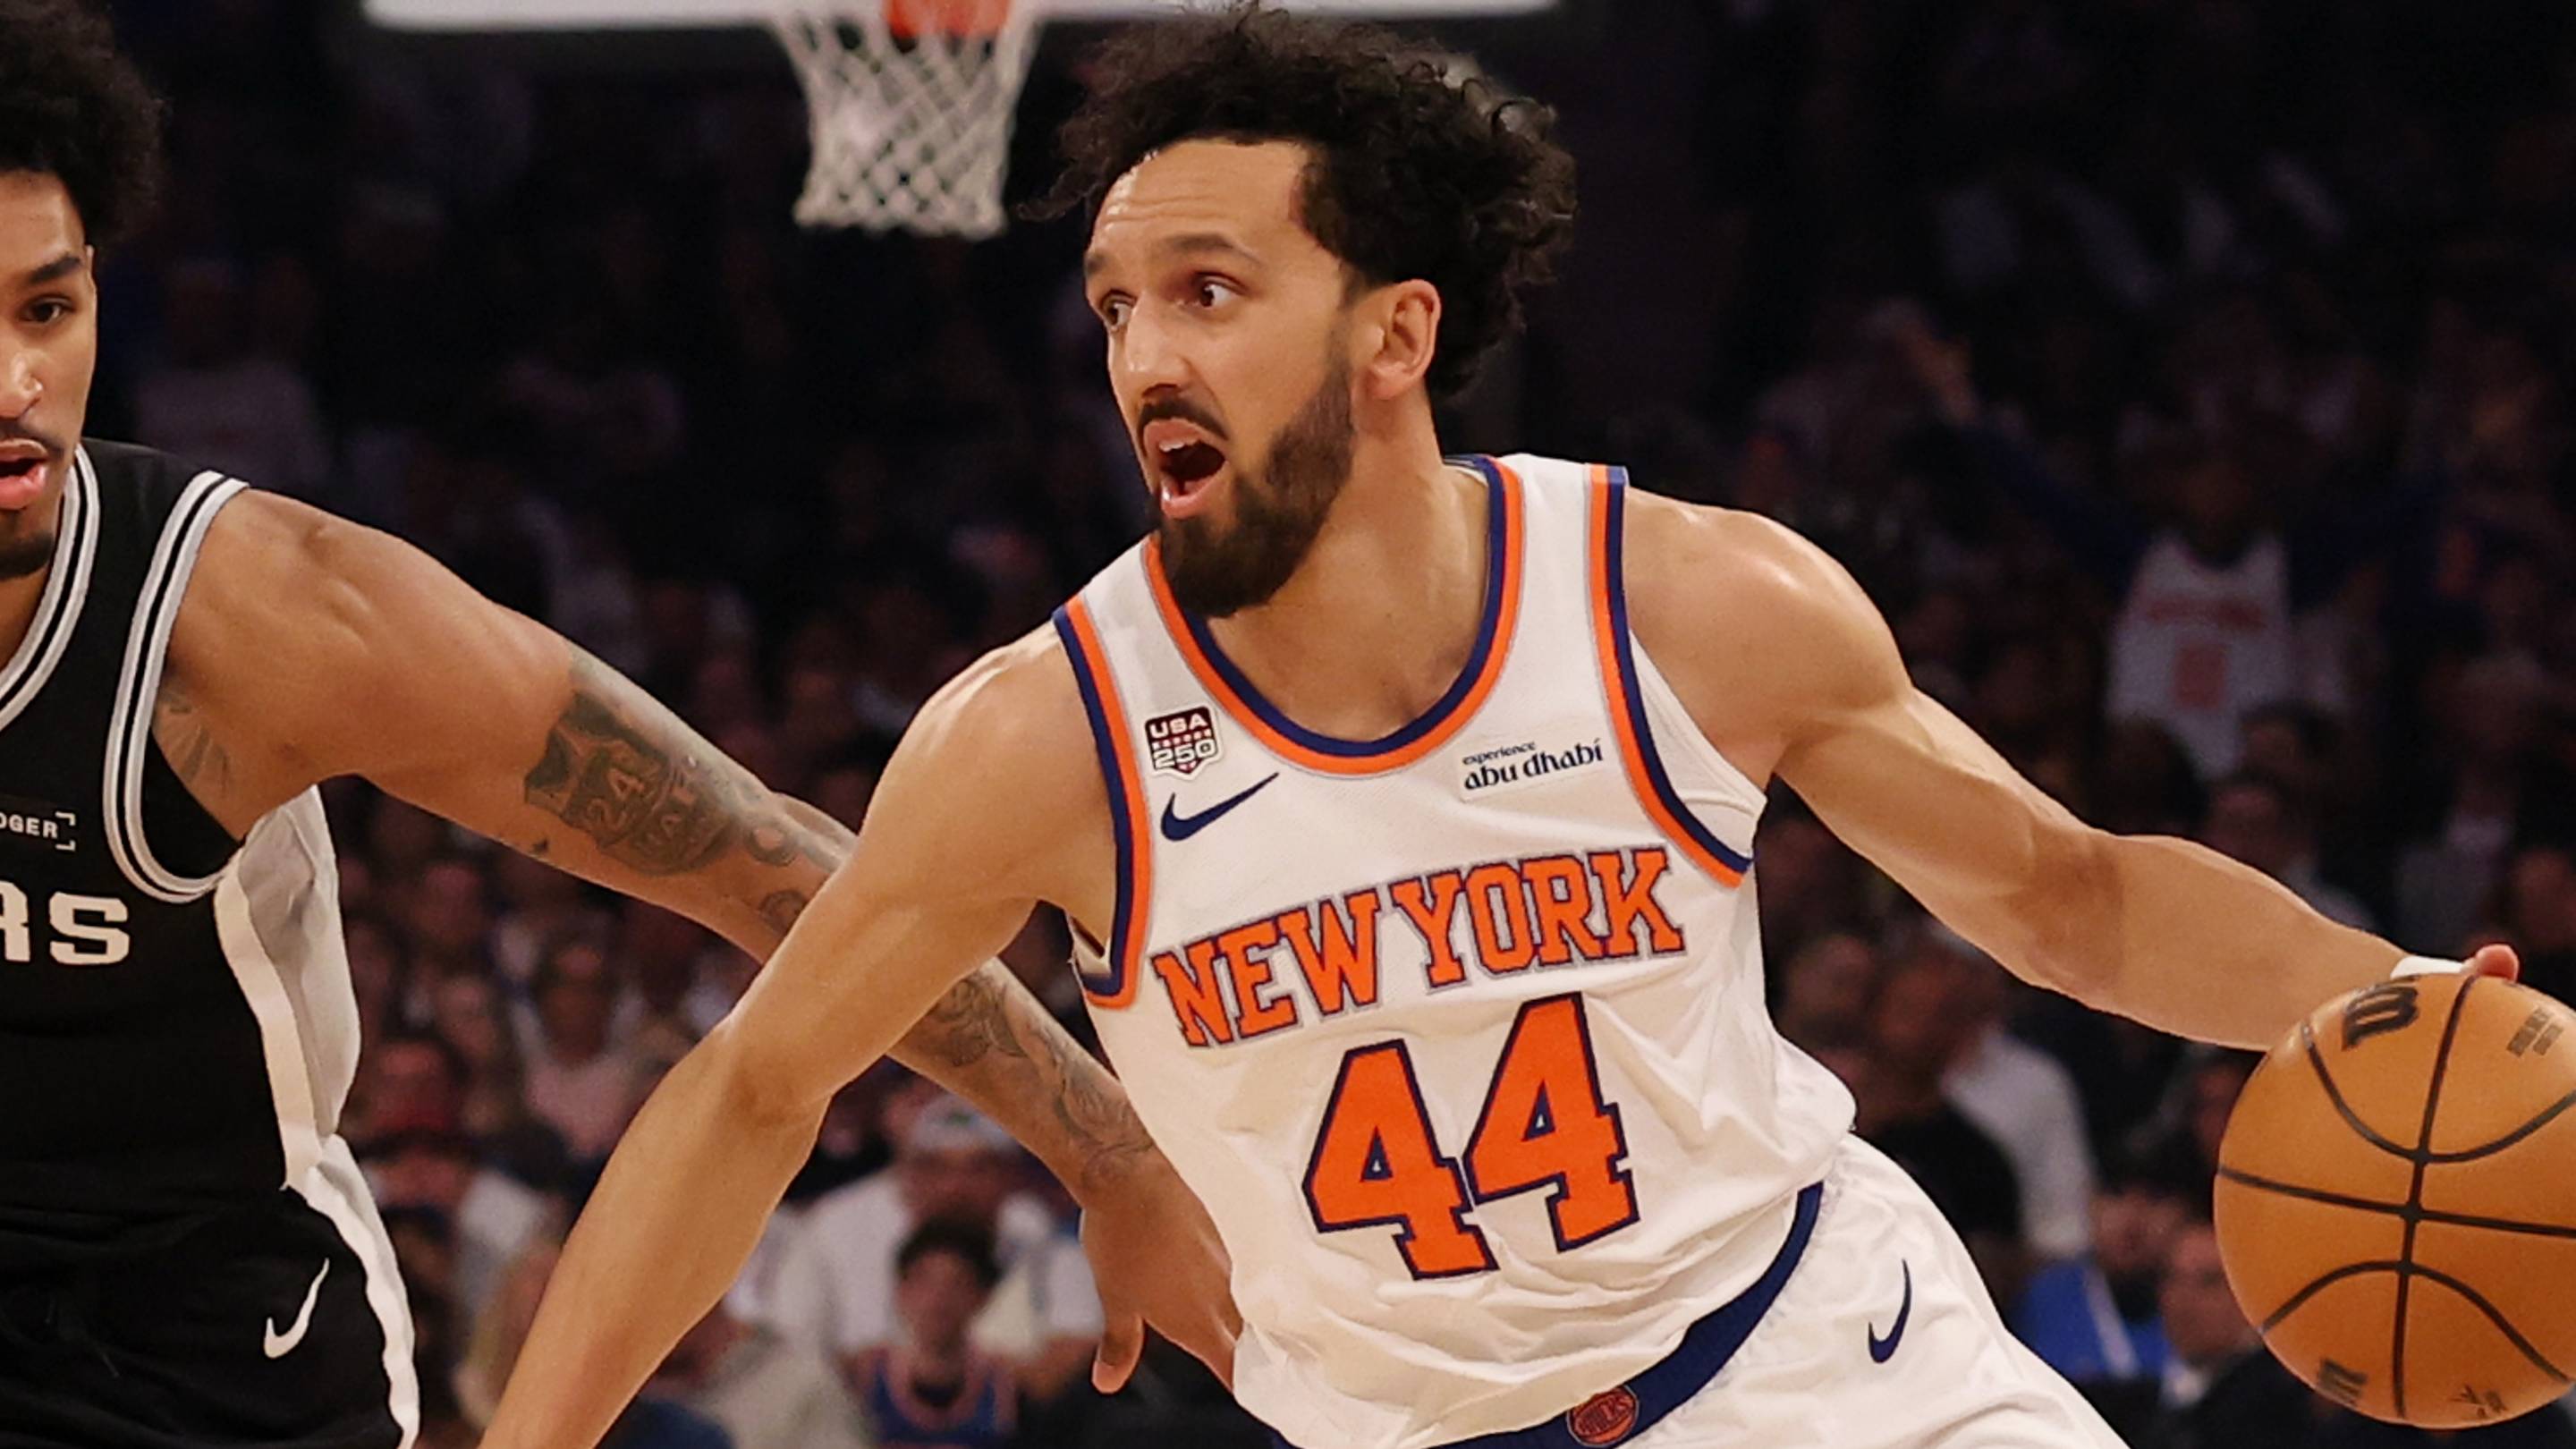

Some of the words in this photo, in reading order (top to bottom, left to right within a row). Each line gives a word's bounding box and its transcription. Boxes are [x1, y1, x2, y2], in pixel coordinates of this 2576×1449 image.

[1148, 713, 1209, 739] USA
[1152, 738, 1218, 769] 250
[1462, 741, 1537, 766] experience
[1463, 763, 1519, 791] abu
[1149, 887, 1383, 1049] NEW
[1391, 844, 1688, 989] YORK
[1301, 990, 1641, 1281] 44
